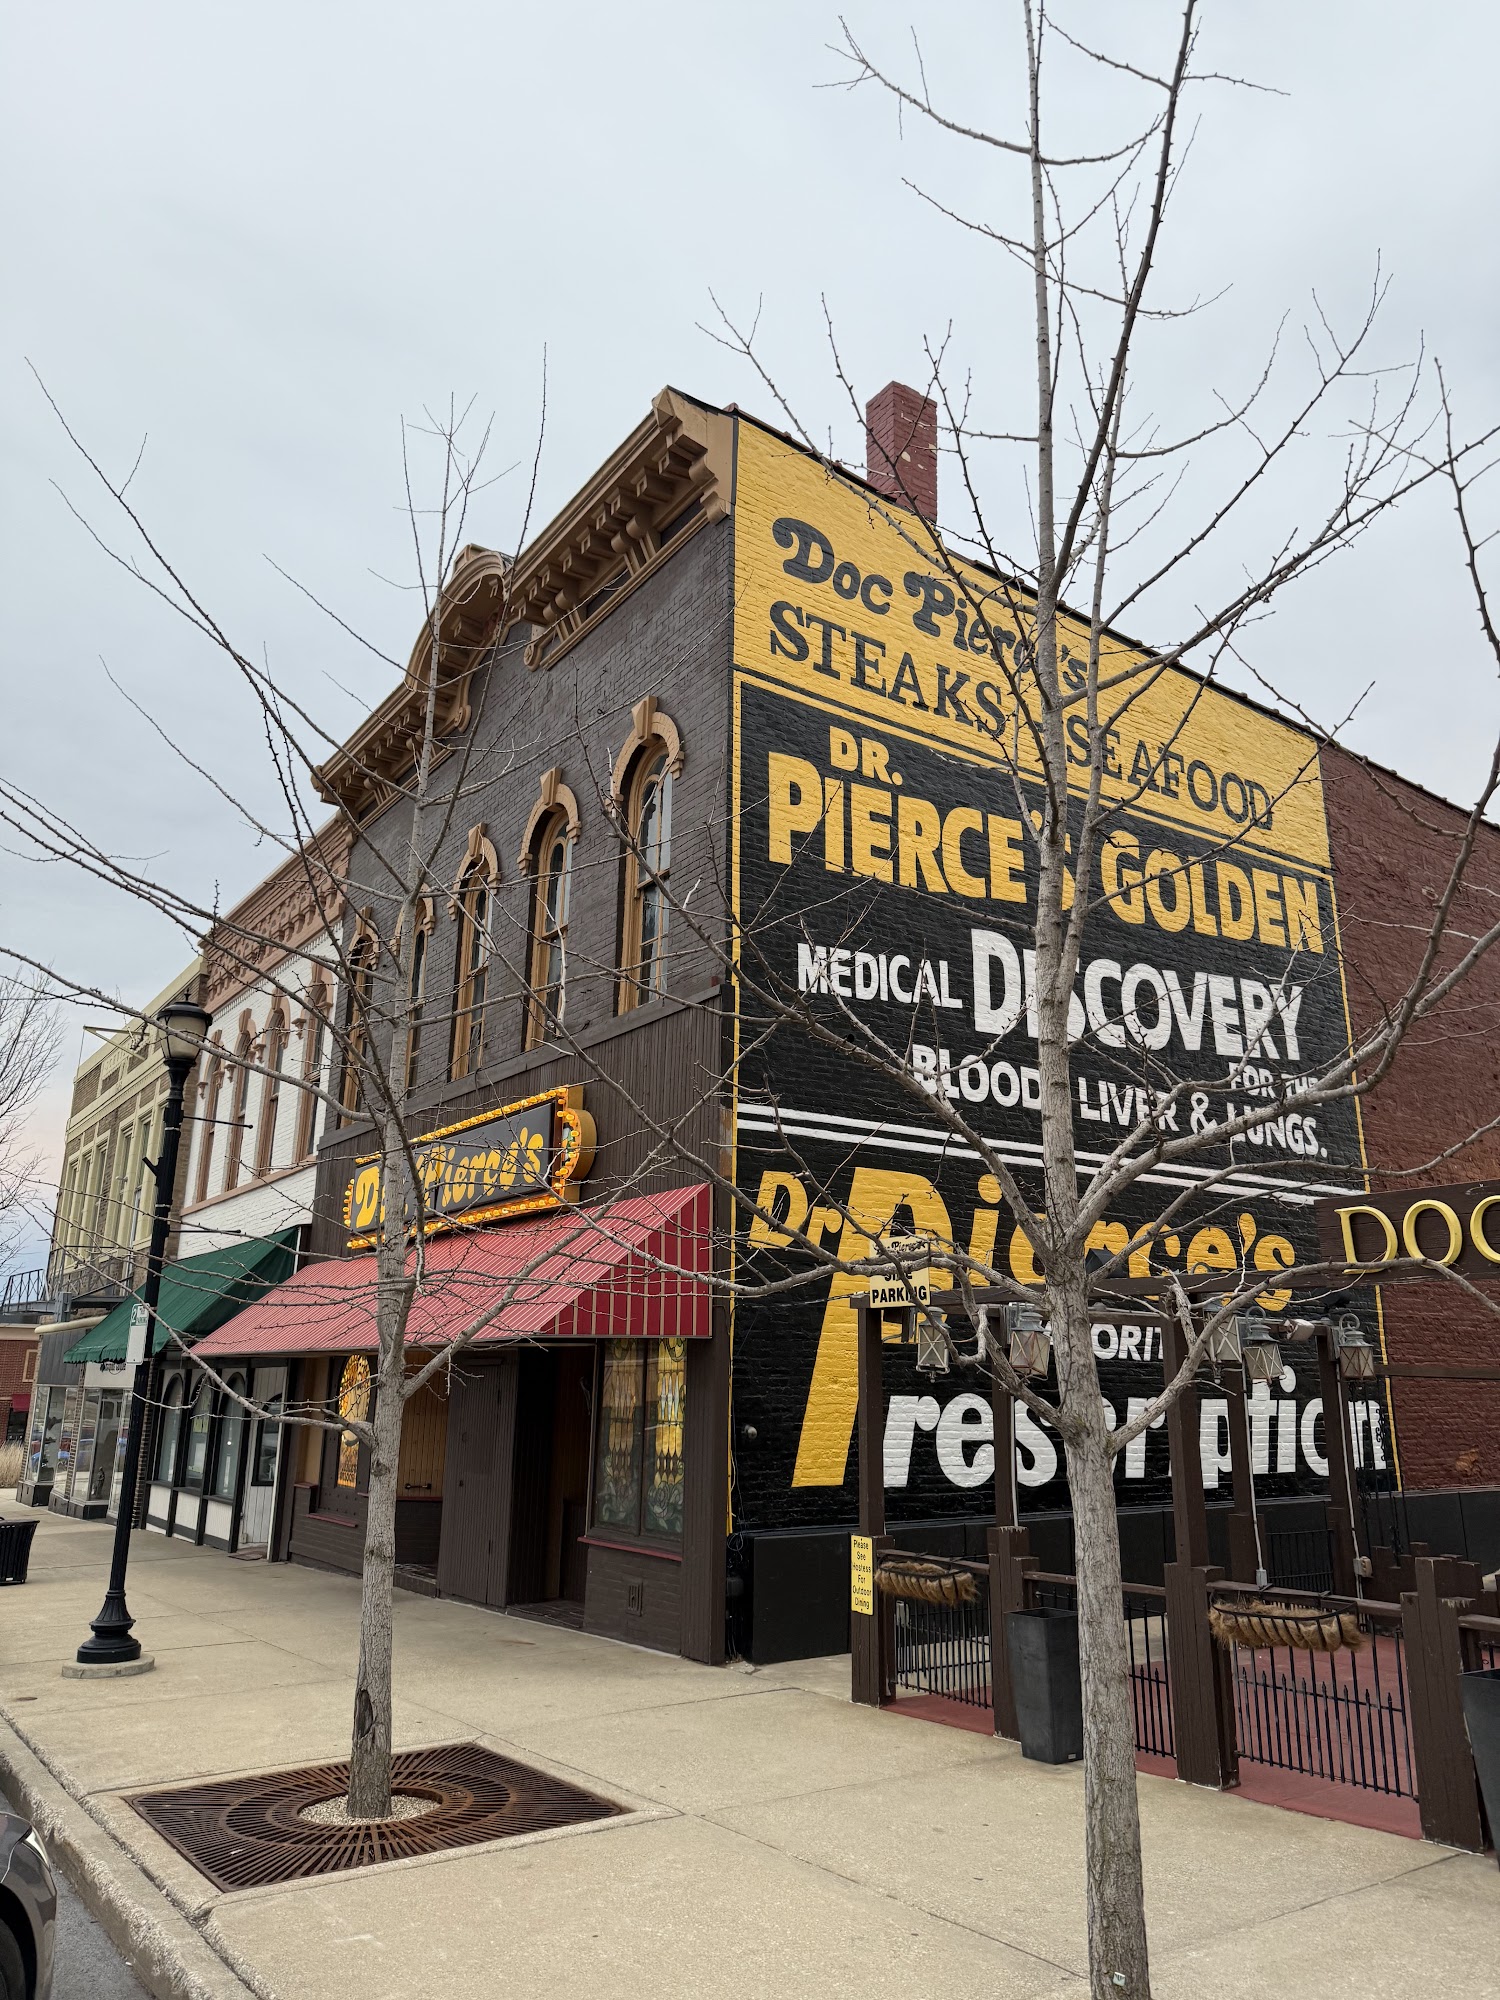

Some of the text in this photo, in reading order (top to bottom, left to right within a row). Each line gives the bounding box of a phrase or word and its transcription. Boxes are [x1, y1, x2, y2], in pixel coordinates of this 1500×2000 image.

[772, 517, 1088, 691] Doc Pierc's
[769, 600, 1273, 830] STEAKS SEAFOOD
[830, 726, 903, 786] DR.
[1102, 829, 1324, 954] GOLDEN
[797, 943, 963, 1009] MEDICAL
[912, 1043, 1328, 1158] BLOOD LIVER & LUNGS.
[1229, 1062, 1277, 1098] FOR
[416, 1127, 544, 1211] Pierce's
[747, 1170, 843, 1253] Dr
[871, 1285, 928, 1303] PARKING
[853, 1539, 869, 1550] Please
[856, 1551, 866, 1561] See
[854, 1597, 870, 1609] Dining
[857, 1574, 866, 1584] For
